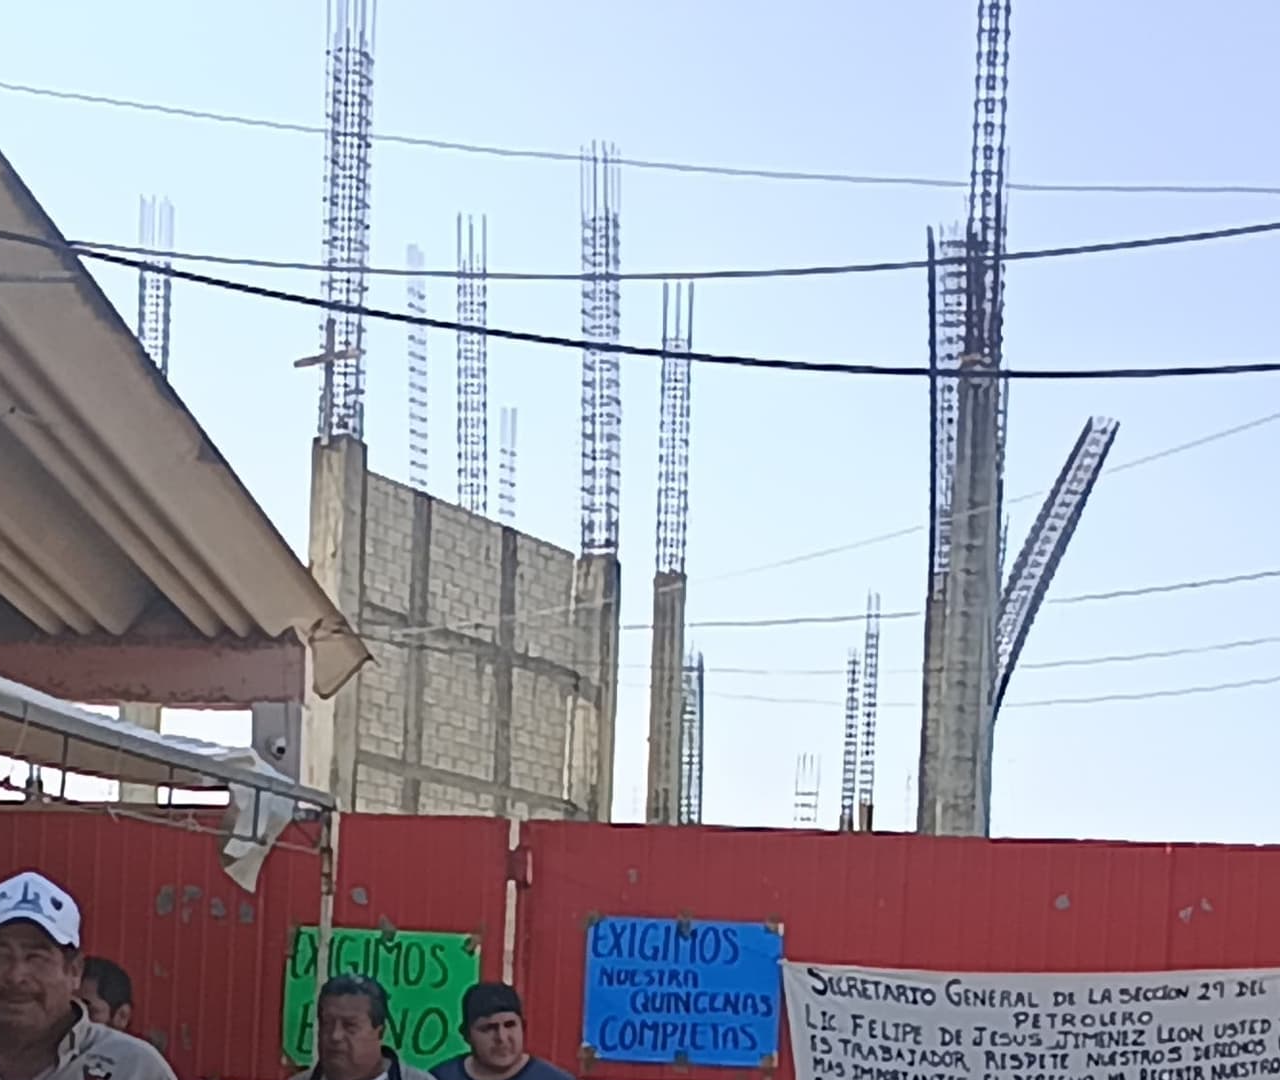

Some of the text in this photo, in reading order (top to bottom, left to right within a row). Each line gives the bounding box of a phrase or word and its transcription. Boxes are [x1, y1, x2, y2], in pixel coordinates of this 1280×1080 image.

[591, 921, 740, 965] EXIGIMOS
[598, 966, 700, 989] NUESTRA
[807, 967, 936, 1006] SECRETARIO
[945, 979, 1039, 1008] GENERAL
[1053, 991, 1075, 1007] DE
[1088, 988, 1112, 1004] LA
[1235, 980, 1267, 998] DEL
[629, 988, 774, 1018] QUINCENAS
[598, 1014, 759, 1052] COMPLETAS
[805, 1003, 836, 1031] LIC
[851, 1014, 922, 1045] FELIPE
[938, 1027, 962, 1046] DE
[972, 1026, 1042, 1047] JESUS
[1045, 1029, 1146, 1050] JIMENEZ
[1214, 1017, 1271, 1038] USTED
[1013, 1011, 1153, 1029] PETROLERO
[813, 1056, 845, 1077] MAS
[1087, 1046, 1183, 1067] NUESTROS
